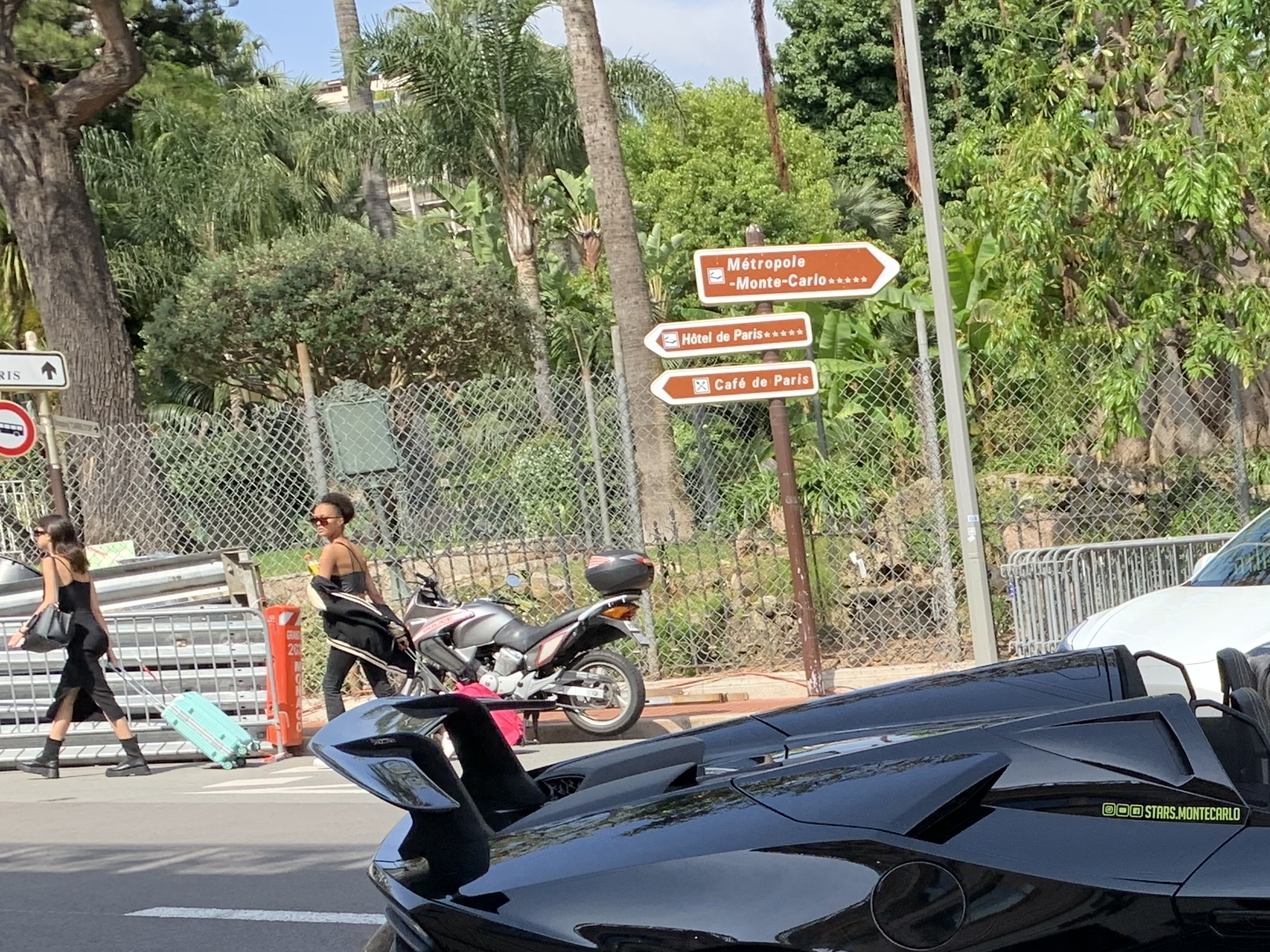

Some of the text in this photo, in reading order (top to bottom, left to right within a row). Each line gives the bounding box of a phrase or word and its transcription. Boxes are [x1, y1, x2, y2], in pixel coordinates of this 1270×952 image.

[727, 255, 806, 272] Métropole
[681, 328, 763, 346] Hôtel de Paris
[714, 372, 809, 391] Café de Paris
[1144, 805, 1241, 821] STARS.MONTECARLO
